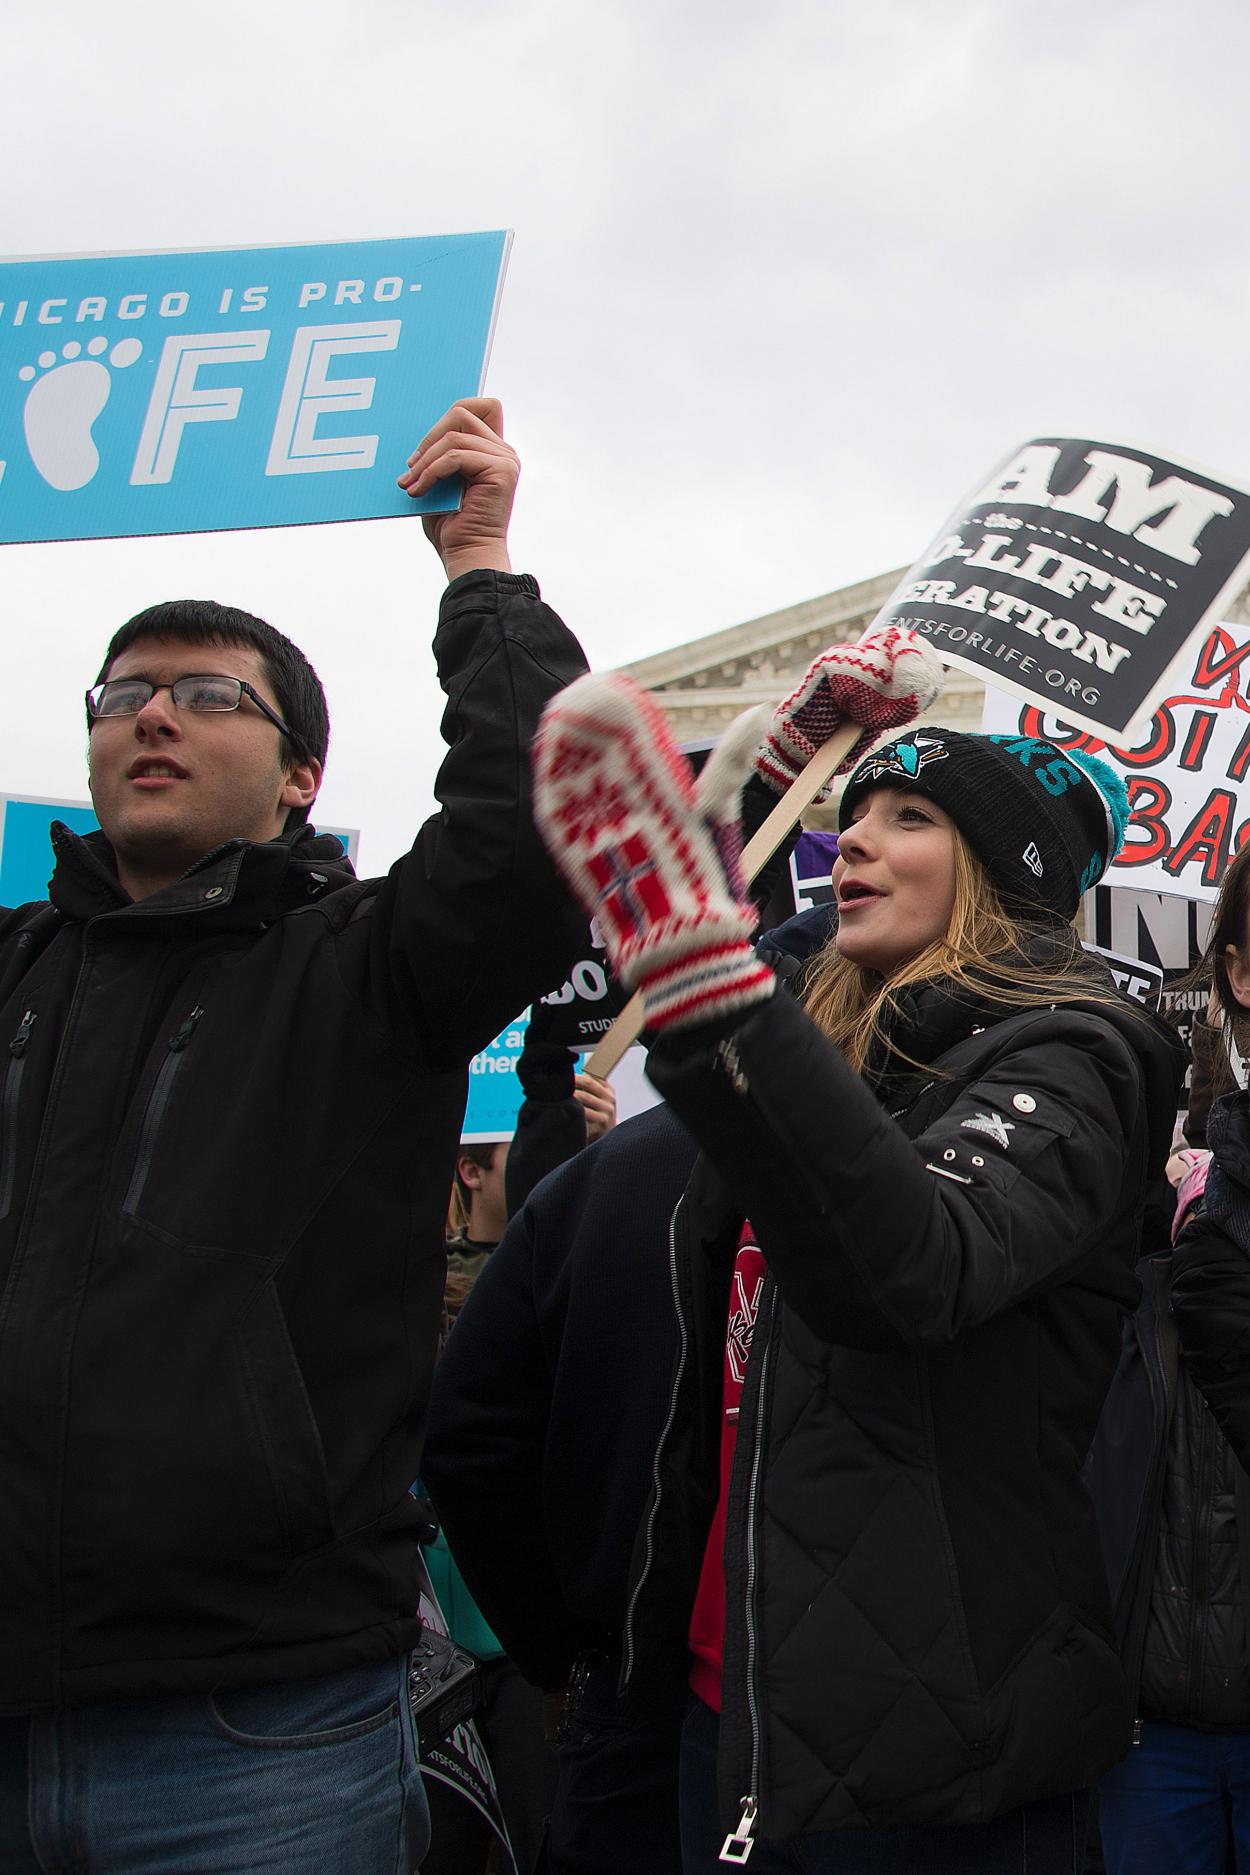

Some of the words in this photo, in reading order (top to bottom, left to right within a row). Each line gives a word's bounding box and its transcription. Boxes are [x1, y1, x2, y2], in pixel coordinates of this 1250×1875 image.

[219, 286, 269, 314] IS
[298, 276, 423, 308] PRO-
[968, 444, 1235, 567] AM
